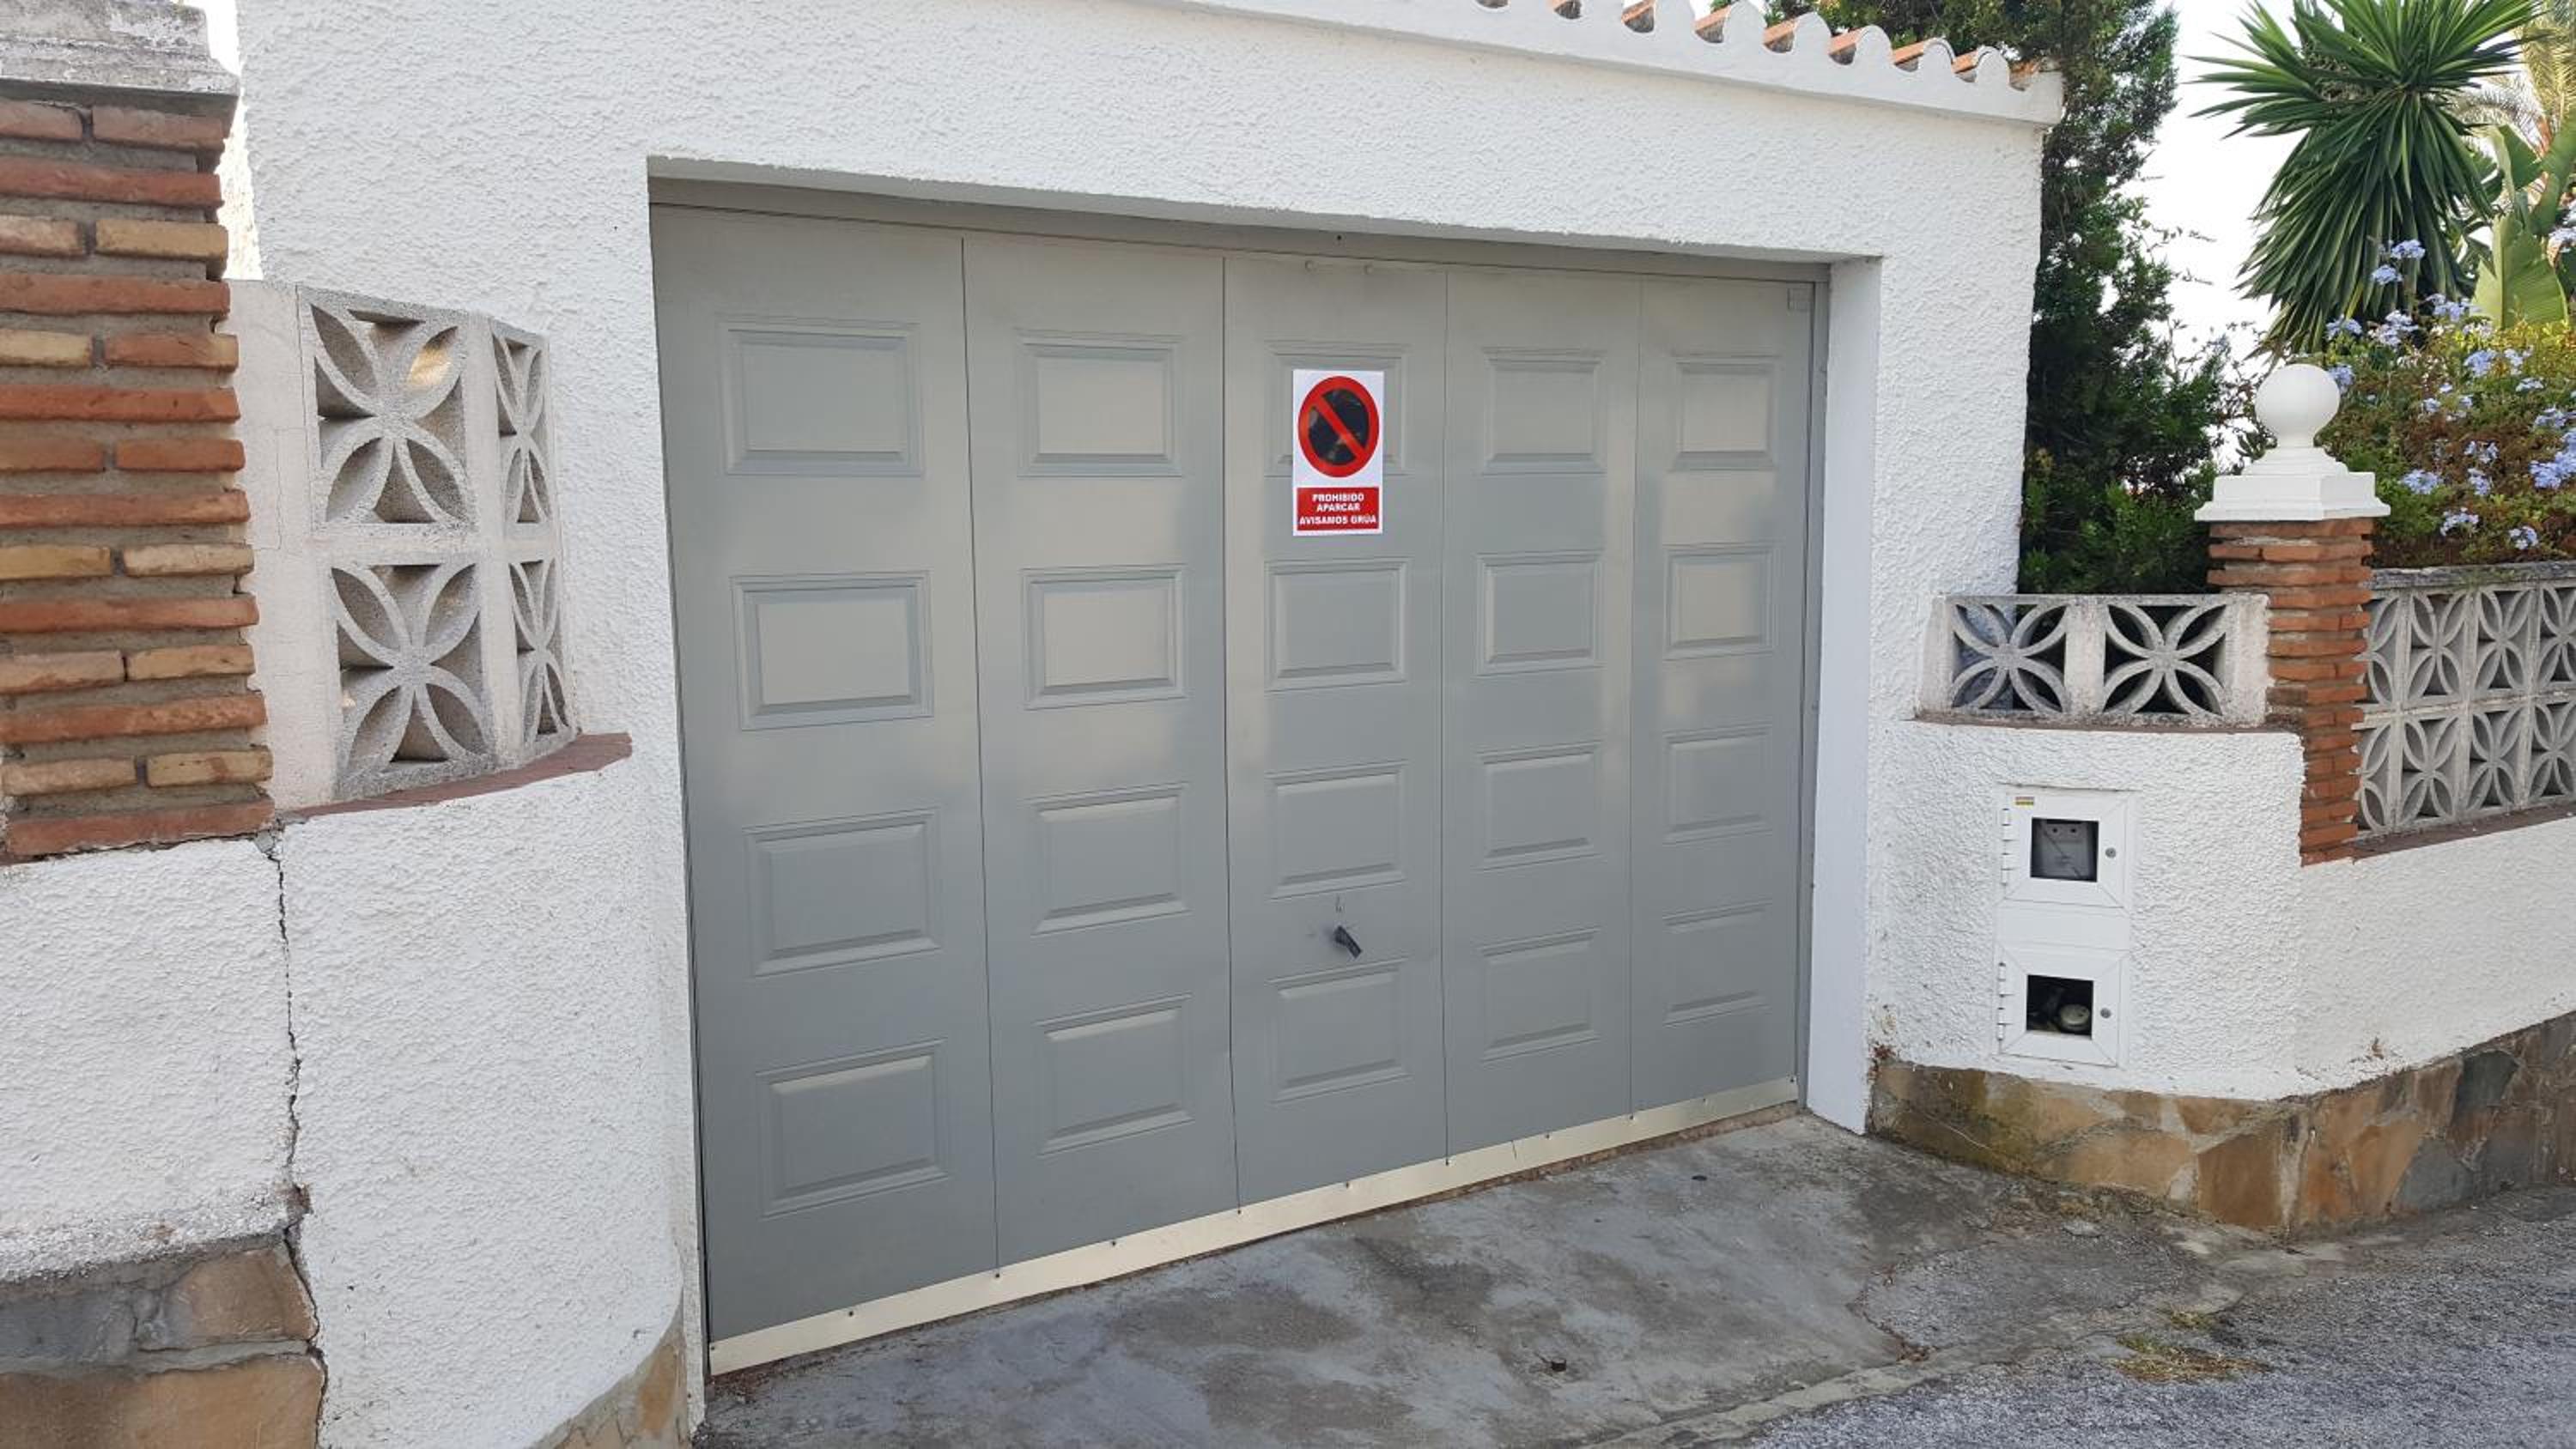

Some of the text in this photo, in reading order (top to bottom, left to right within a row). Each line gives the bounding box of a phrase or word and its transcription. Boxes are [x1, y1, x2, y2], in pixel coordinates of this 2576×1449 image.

[1312, 493, 1364, 502] PROHIBIDO
[1316, 502, 1360, 512] APARCAR
[1299, 516, 1348, 524] AVISAMOS
